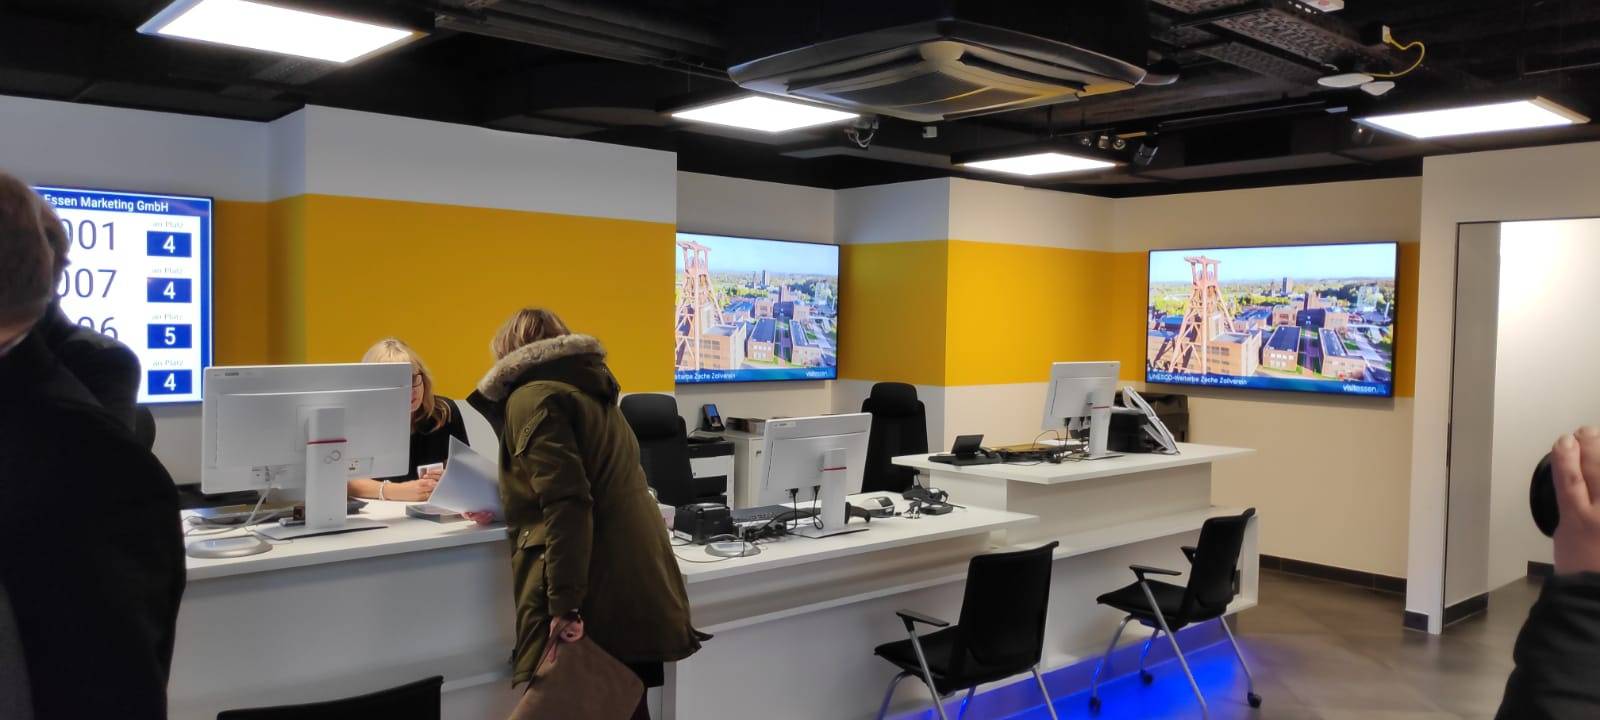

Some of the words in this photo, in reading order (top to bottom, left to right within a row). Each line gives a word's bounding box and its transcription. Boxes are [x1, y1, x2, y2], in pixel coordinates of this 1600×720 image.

[80, 196, 134, 212] Marketing
[136, 200, 169, 212] GmbH
[162, 235, 176, 253] 4
[163, 281, 176, 300] 4
[164, 327, 176, 345] 5
[163, 373, 177, 391] 4
